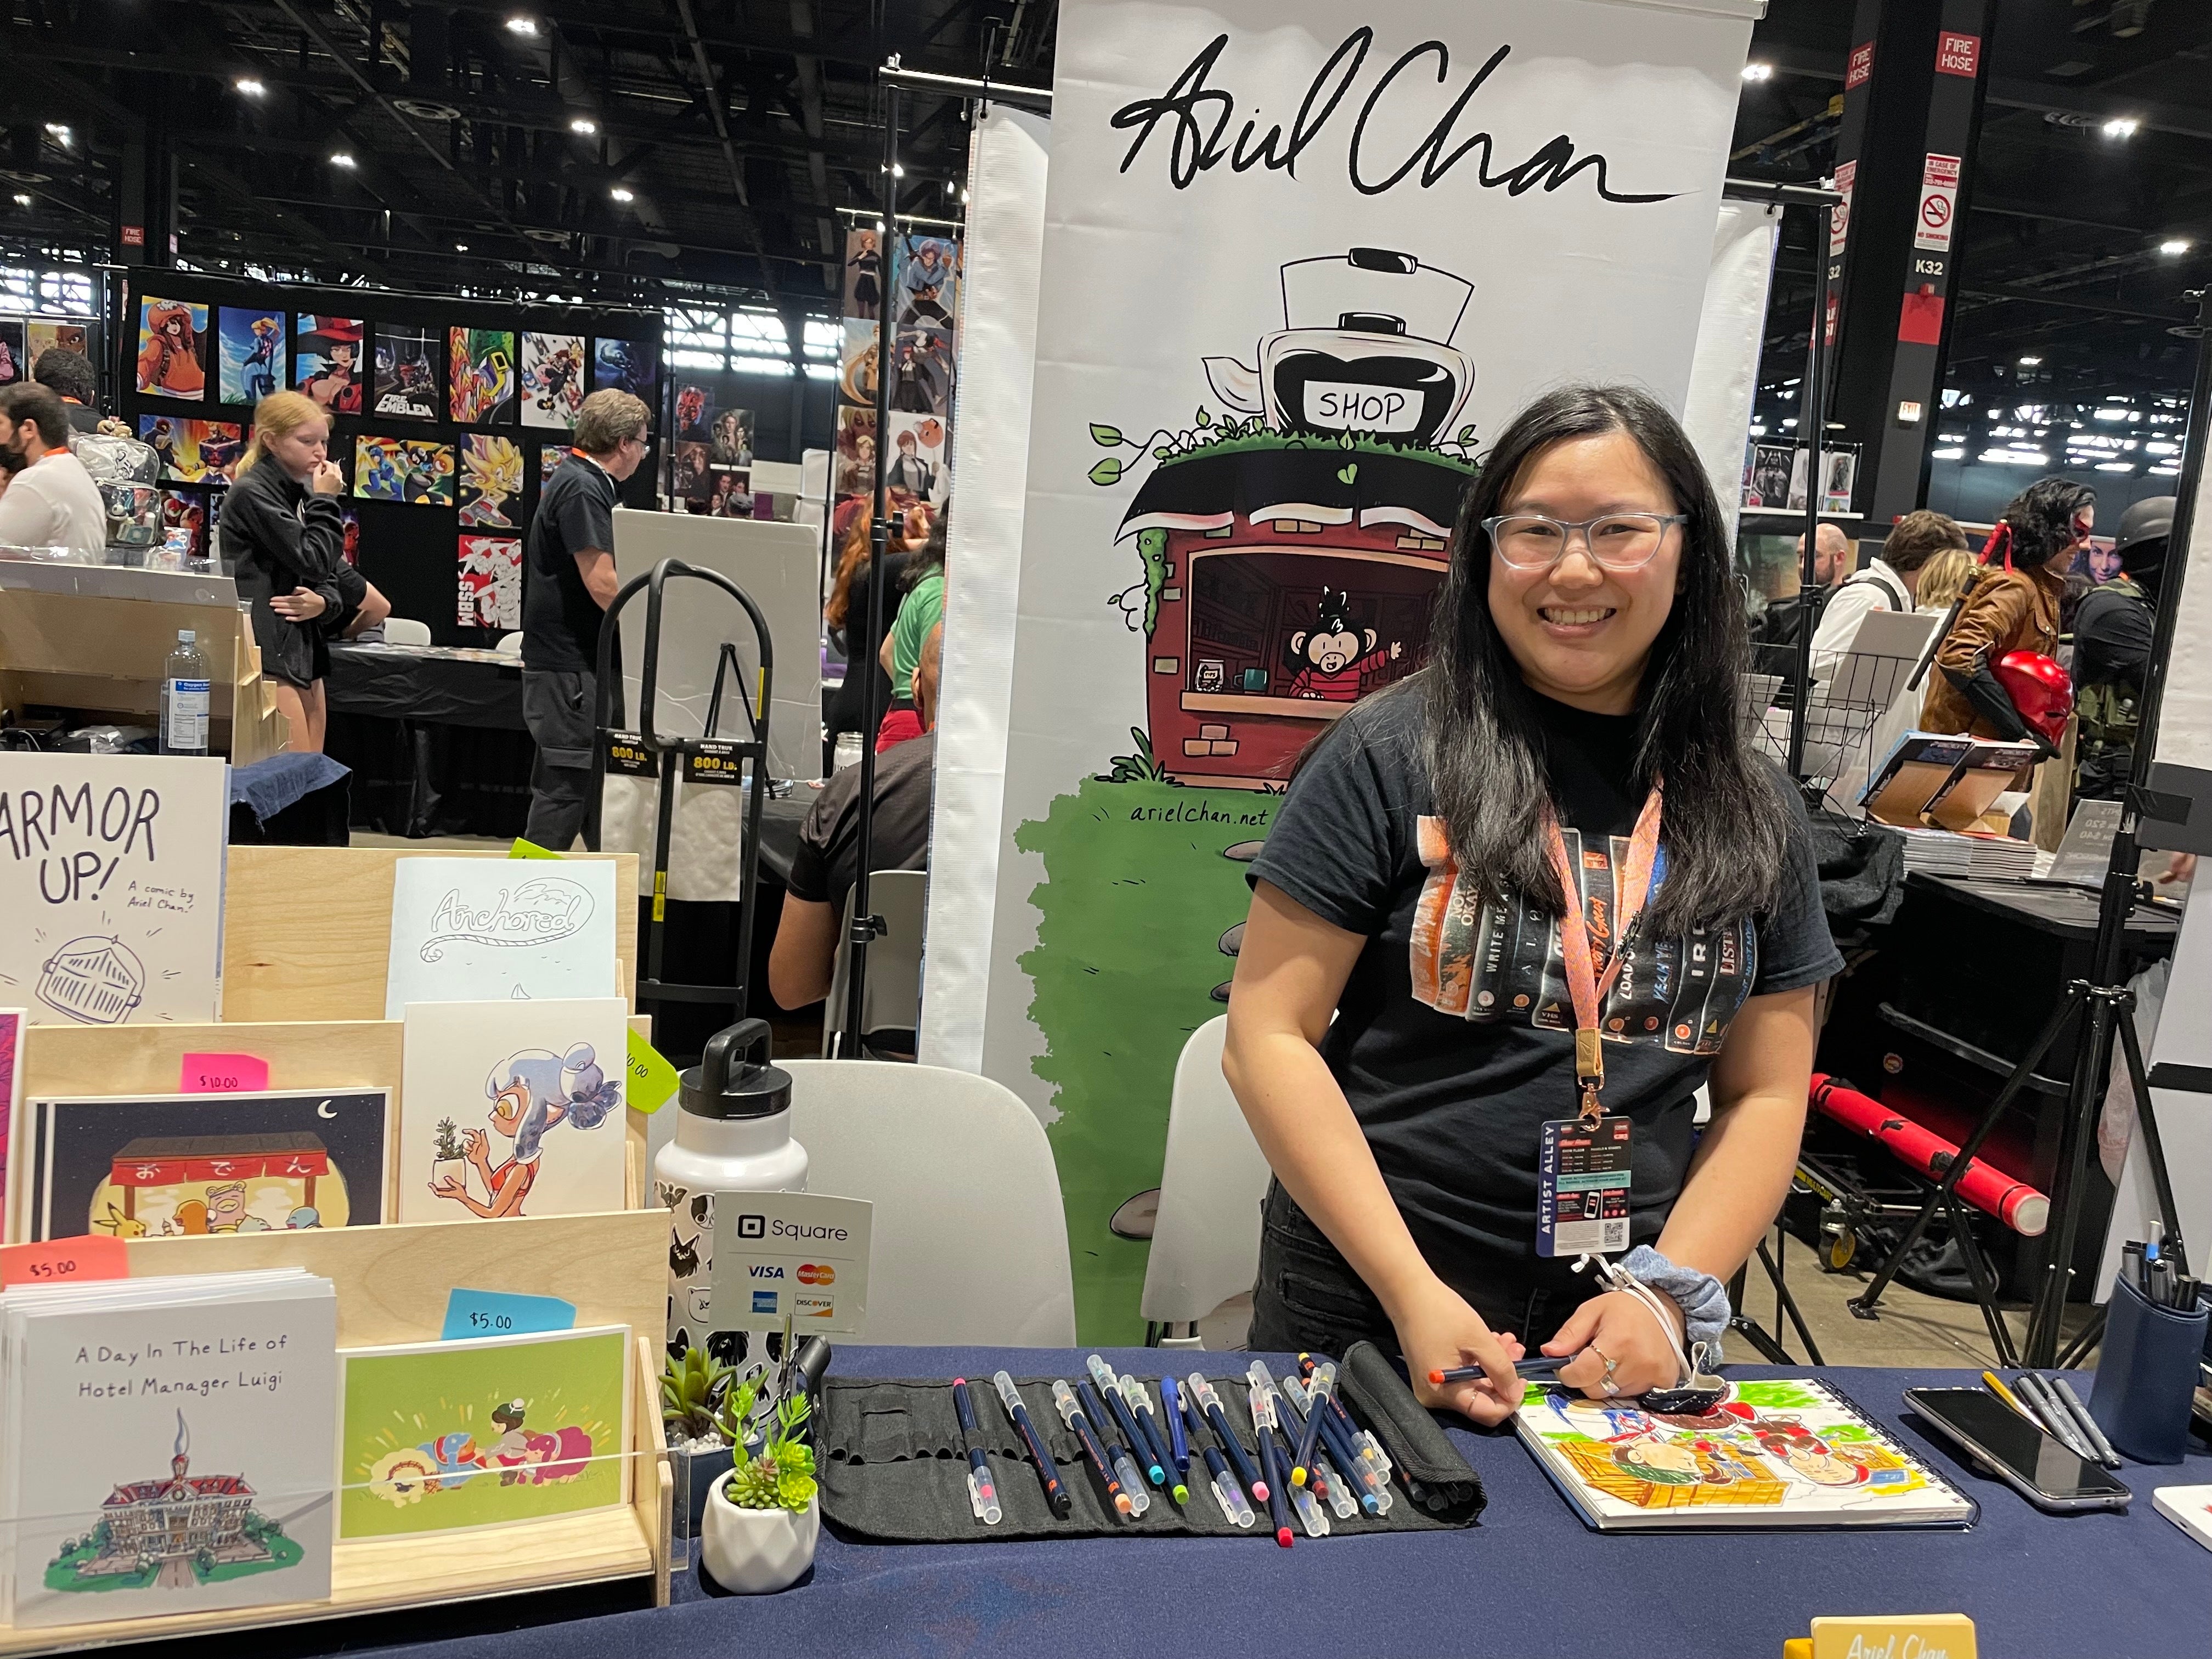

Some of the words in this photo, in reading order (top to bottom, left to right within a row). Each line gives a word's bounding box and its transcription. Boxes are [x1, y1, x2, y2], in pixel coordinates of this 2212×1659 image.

[1945, 37, 1973, 54] FIRE
[1852, 48, 1871, 67] FIRE
[1942, 54, 1973, 71] HOSE
[1849, 63, 1870, 83] HOSE
[1349, 41, 1704, 202] Chan
[1829, 265, 1841, 280] 32
[1915, 259, 1943, 275] K32
[375, 400, 434, 417] EMBLEM
[383, 393, 408, 403] FIRE
[1319, 392, 1405, 425] SHOP
[458, 580, 475, 627] SSBM
[612, 746, 633, 759] 800
[693, 757, 721, 769] 800
[0, 782, 160, 862] ARMOR
[40, 851, 120, 904] UP!
[127, 880, 137, 891] A
[144, 885, 176, 897] comic
[180, 888, 194, 904] by
[127, 896, 152, 909] Ariel
[431, 888, 582, 933] Anchored
[1453, 888, 1465, 919] NOT
[1460, 882, 1479, 927] OKAY
[1485, 931, 1504, 973] WRITE
[1496, 906, 1508, 925] ME
[1620, 963, 1634, 1000] LOAD
[627, 1053, 648, 1078] 10.00
[1544, 1126, 1554, 1174] ALLEY
[1541, 1180, 1553, 1234] ARTIST
[772, 1220, 848, 1241] Square
[30, 1260, 76, 1277] $5.00
[747, 1265, 785, 1279] VISA
[797, 1270, 835, 1280] MasterCard
[796, 1299, 832, 1307] DISCOVER
[469, 1312, 511, 1329] $5.00
[75, 1346, 89, 1364] A
[97, 1346, 139, 1367] Day
[146, 1343, 162, 1358] In
[172, 1340, 211, 1357] The
[219, 1337, 257, 1354] Life
[266, 1334, 288, 1350] of
[78, 1379, 133, 1398] Hotel
[140, 1377, 229, 1397] Manager
[238, 1370, 283, 1392] Luigi
[1846, 1633, 1896, 1659] Ariel
